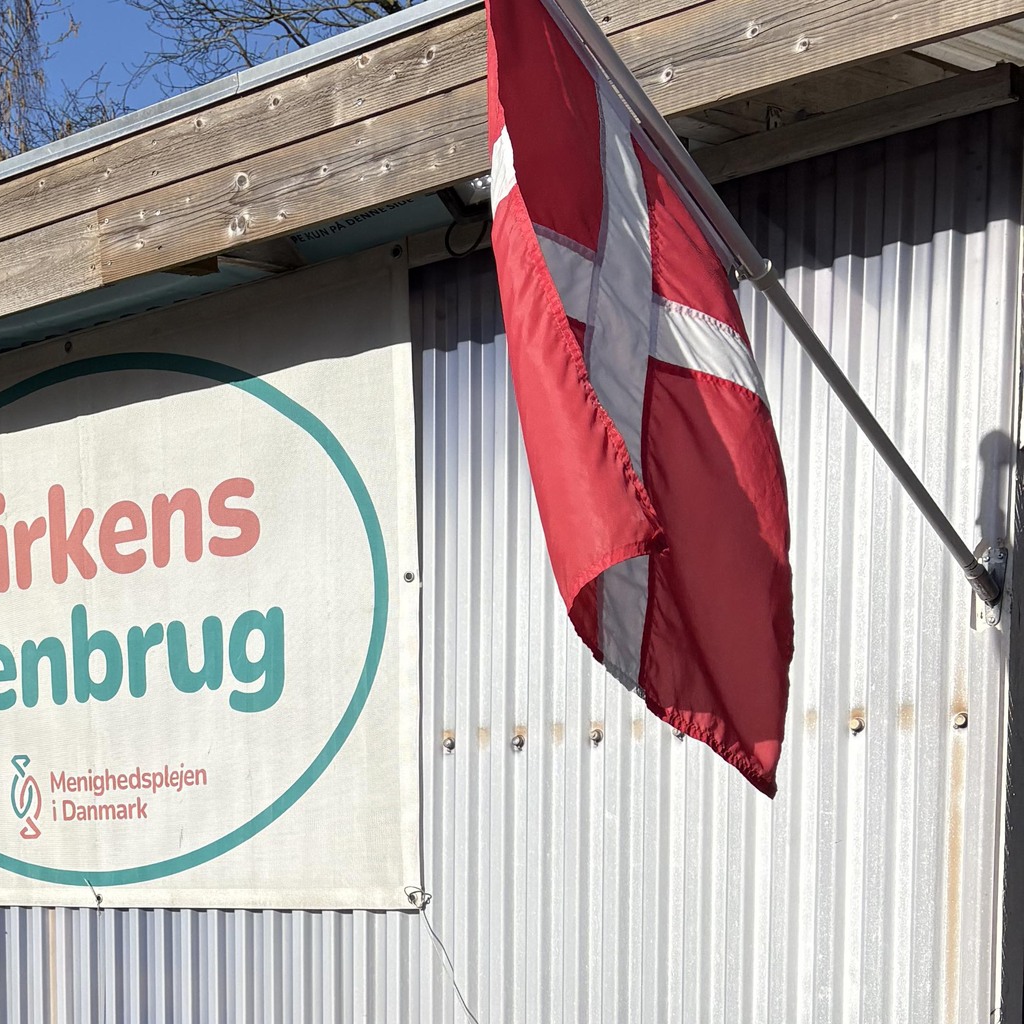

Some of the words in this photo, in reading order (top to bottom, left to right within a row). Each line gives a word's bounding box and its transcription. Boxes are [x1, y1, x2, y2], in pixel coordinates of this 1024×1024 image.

[306, 228, 329, 242] KUN
[330, 221, 346, 235] PÅ
[347, 208, 387, 226] DENNE
[50, 763, 207, 796] Menighedsplejen
[52, 799, 57, 821] i
[62, 797, 147, 821] Danmark
